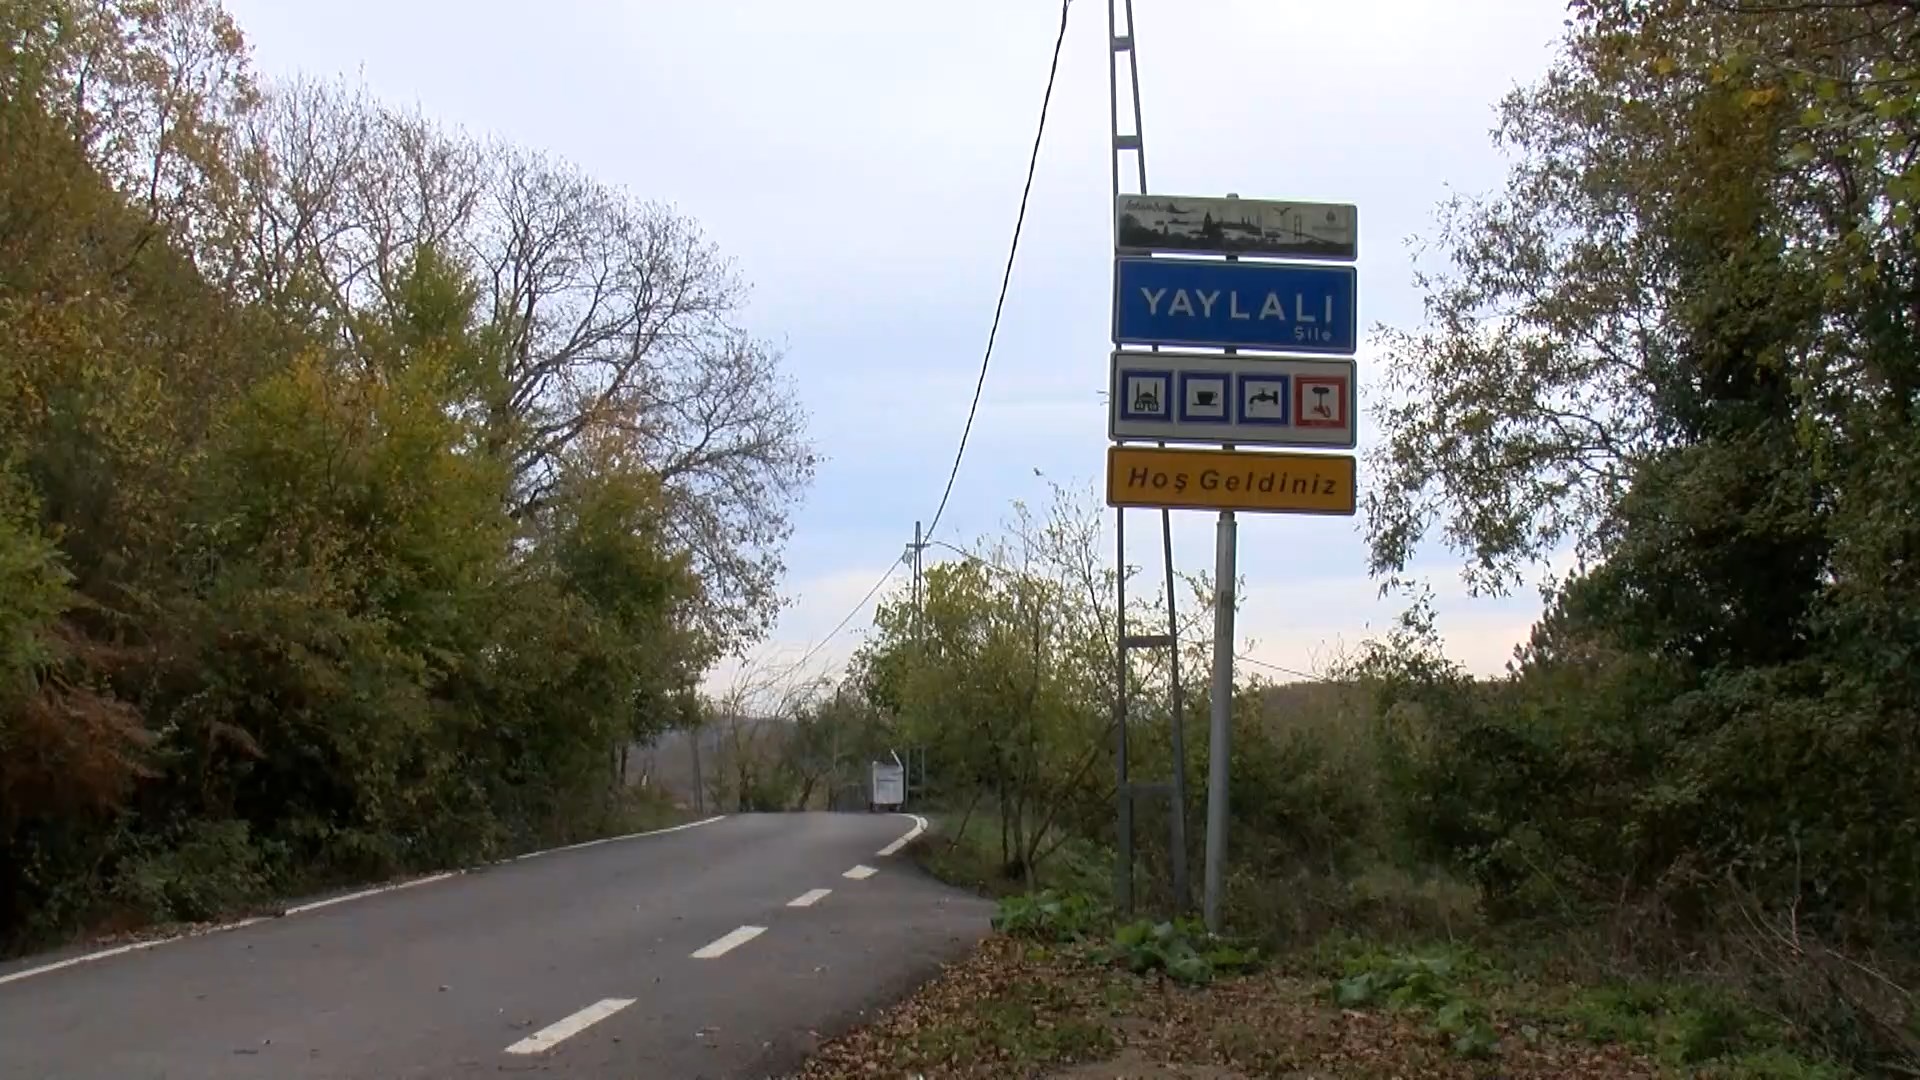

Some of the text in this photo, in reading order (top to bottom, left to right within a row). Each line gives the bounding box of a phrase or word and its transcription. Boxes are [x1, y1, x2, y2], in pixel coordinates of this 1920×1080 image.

[1141, 287, 1333, 324] YAYLALI
[1128, 467, 1336, 495] Hoş Geldiniz
